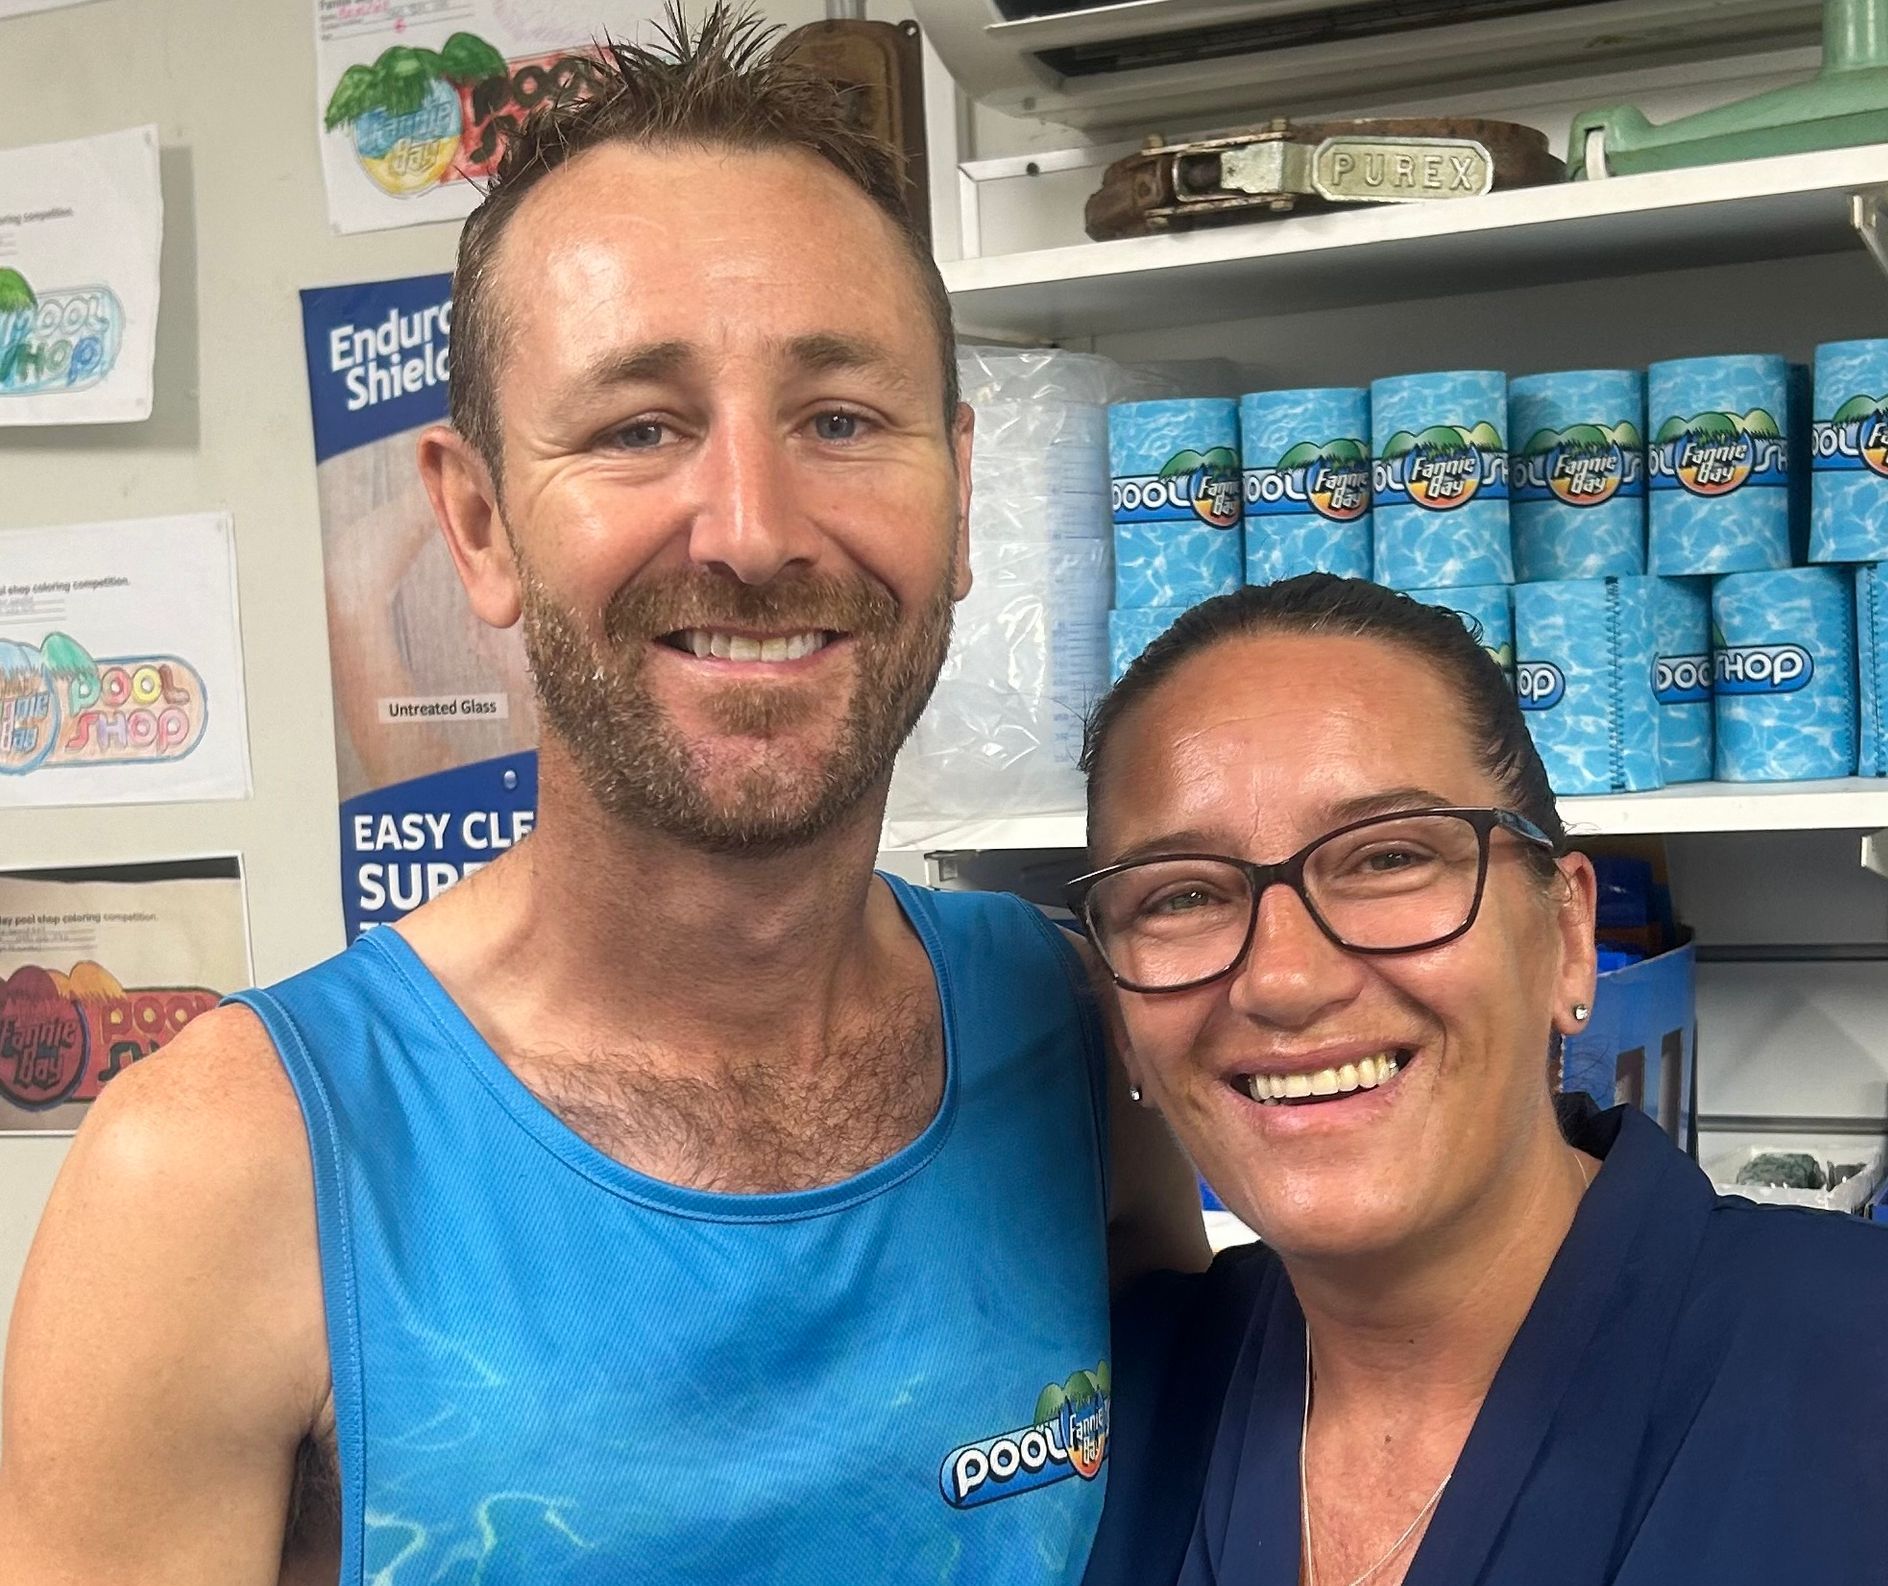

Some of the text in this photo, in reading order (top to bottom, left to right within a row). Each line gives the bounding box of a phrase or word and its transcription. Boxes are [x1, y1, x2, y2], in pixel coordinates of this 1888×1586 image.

[1332, 152, 1473, 191] PUREX
[1554, 454, 1617, 478] Fannie
[1682, 441, 1748, 467] Fannie
[1411, 456, 1476, 481] Fannie
[1697, 460, 1735, 484] Bay
[1246, 473, 1308, 503] OOL
[1427, 474, 1465, 499] Bay
[1571, 472, 1607, 495] Bay
[70, 664, 190, 718] POOL
[389, 699, 497, 717] Untreated Glass
[65, 706, 189, 754] SHOP
[354, 813, 451, 851] EASY
[1069, 1407, 1104, 1448] Fannie
[956, 1426, 1068, 1498] POOL
